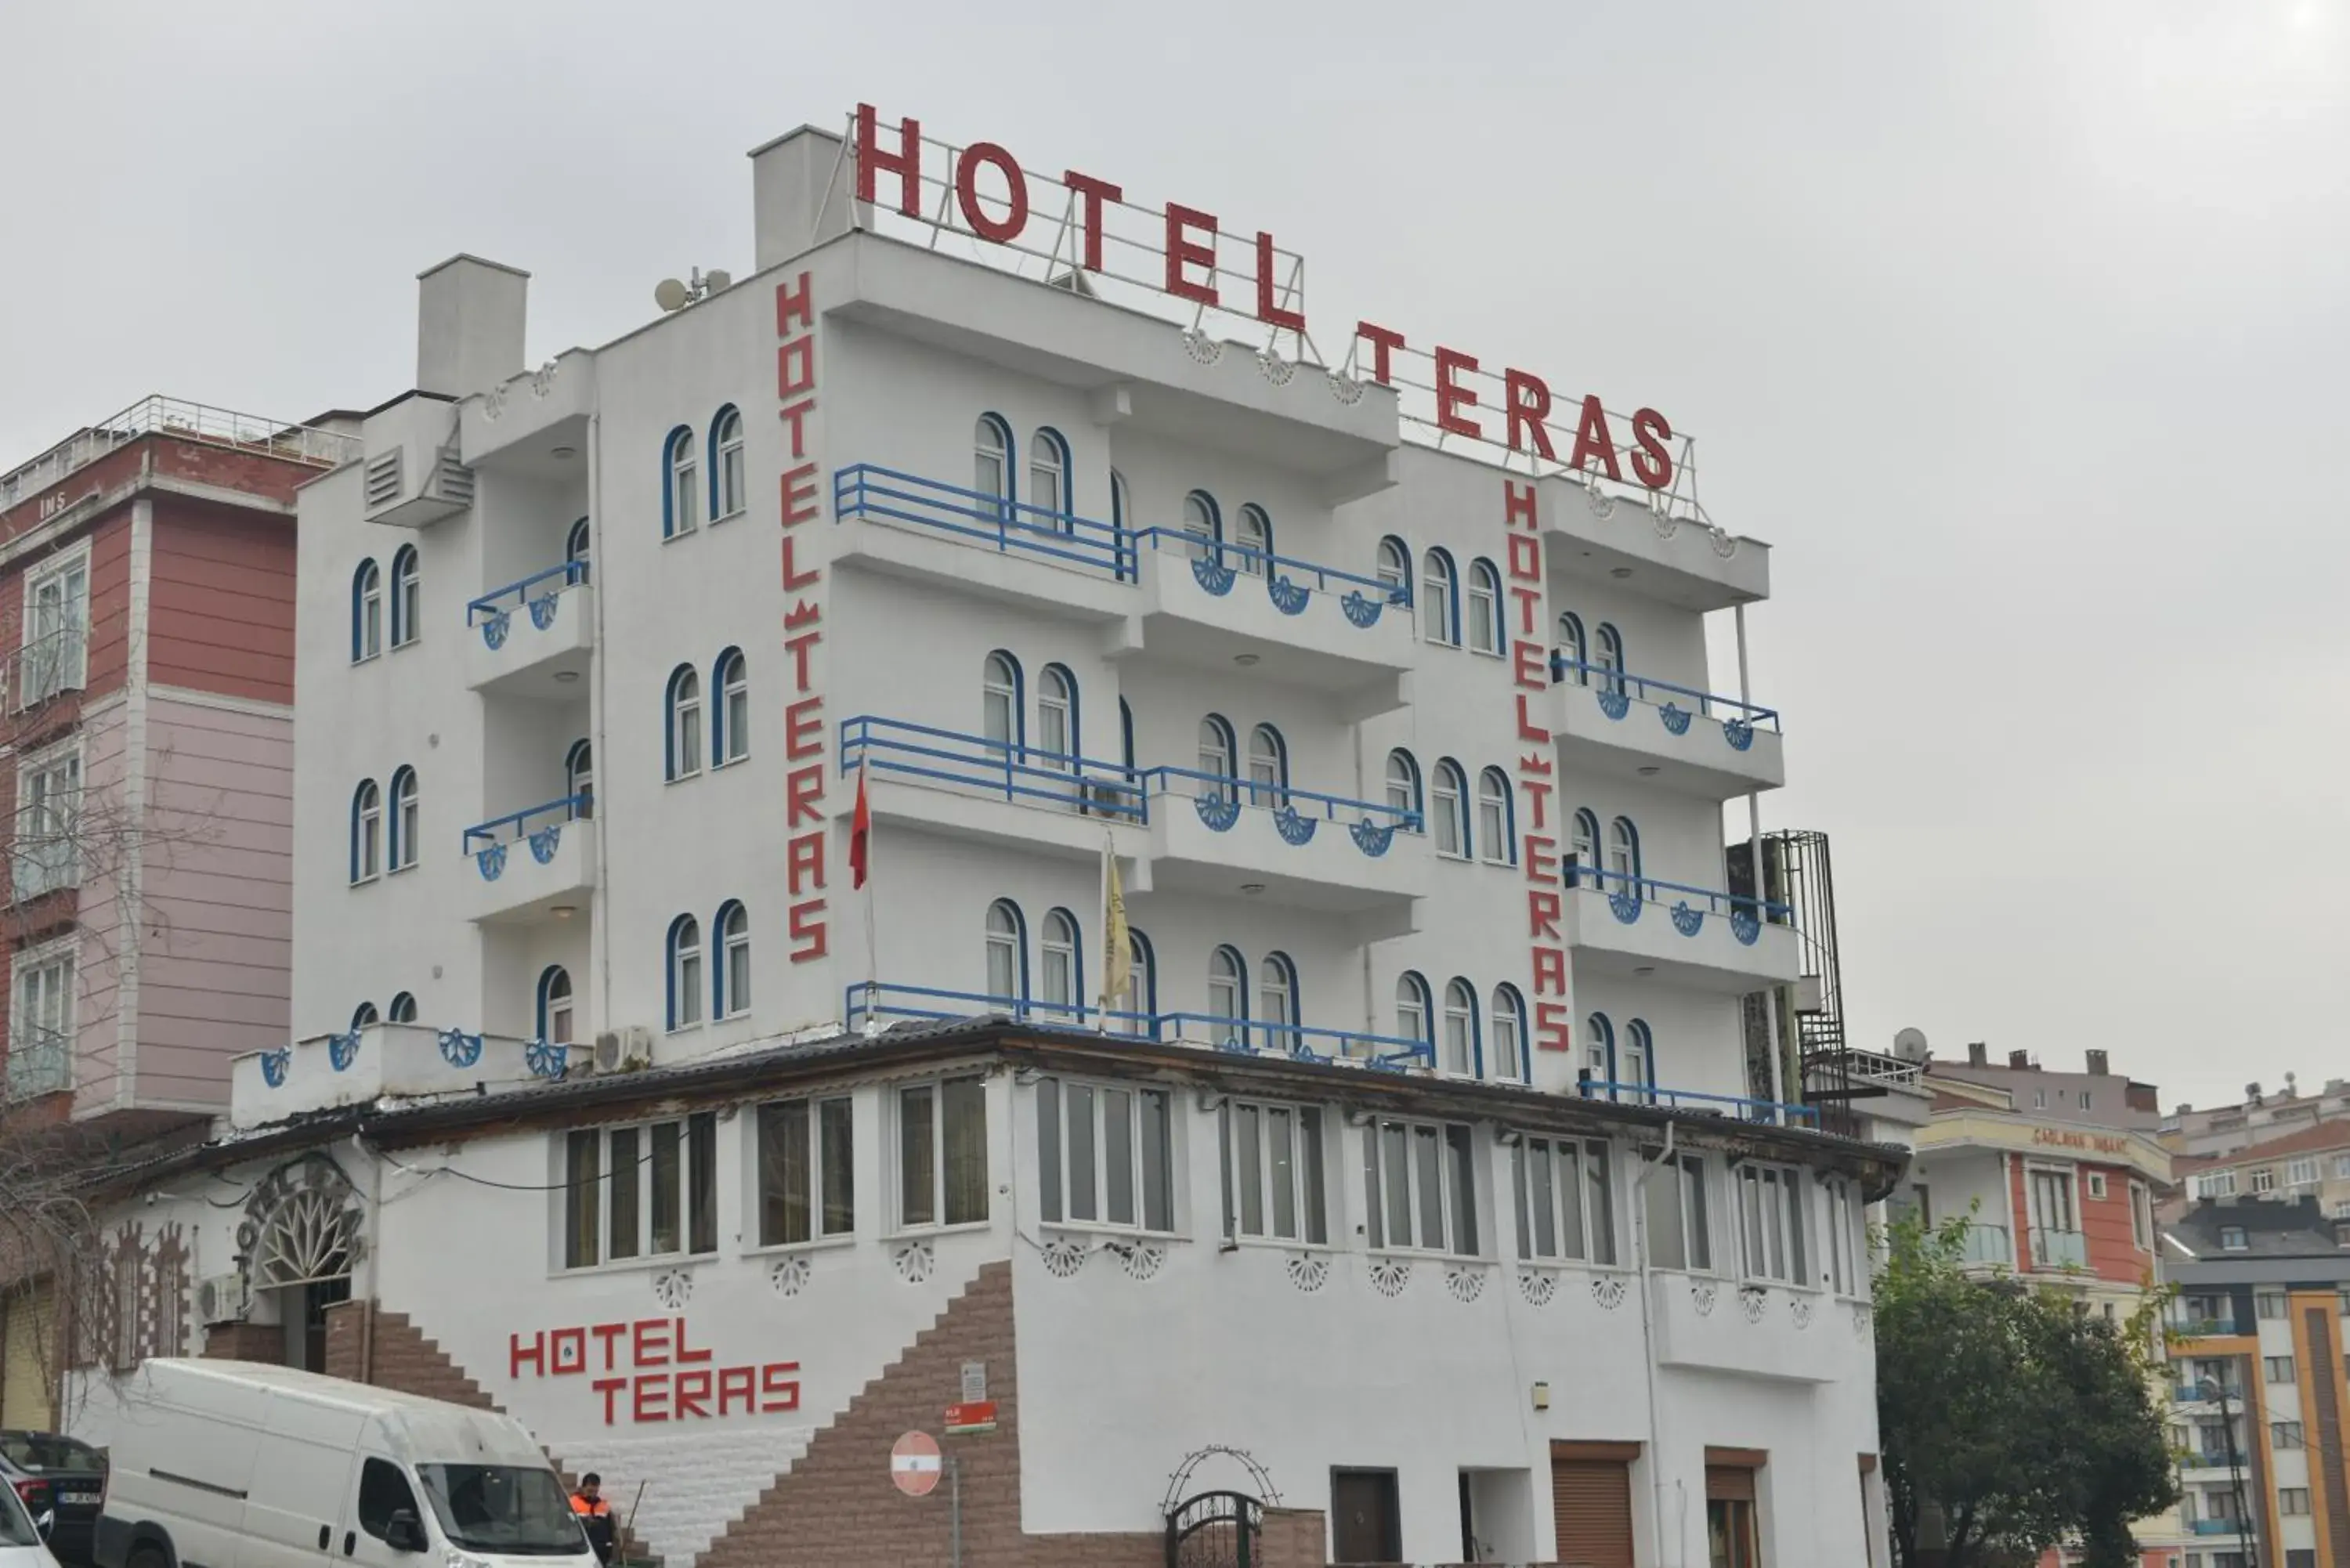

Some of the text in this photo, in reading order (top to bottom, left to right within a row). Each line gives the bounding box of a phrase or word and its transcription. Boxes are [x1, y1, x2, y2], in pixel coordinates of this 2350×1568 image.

[857, 103, 1672, 489] HOTEL TERAS
[776, 271, 826, 962] HOTEL TERAS
[1505, 479, 1569, 1053] HOTEL TERAS
[510, 1317, 712, 1379] HOTEL
[592, 1362, 800, 1426] TERAS
